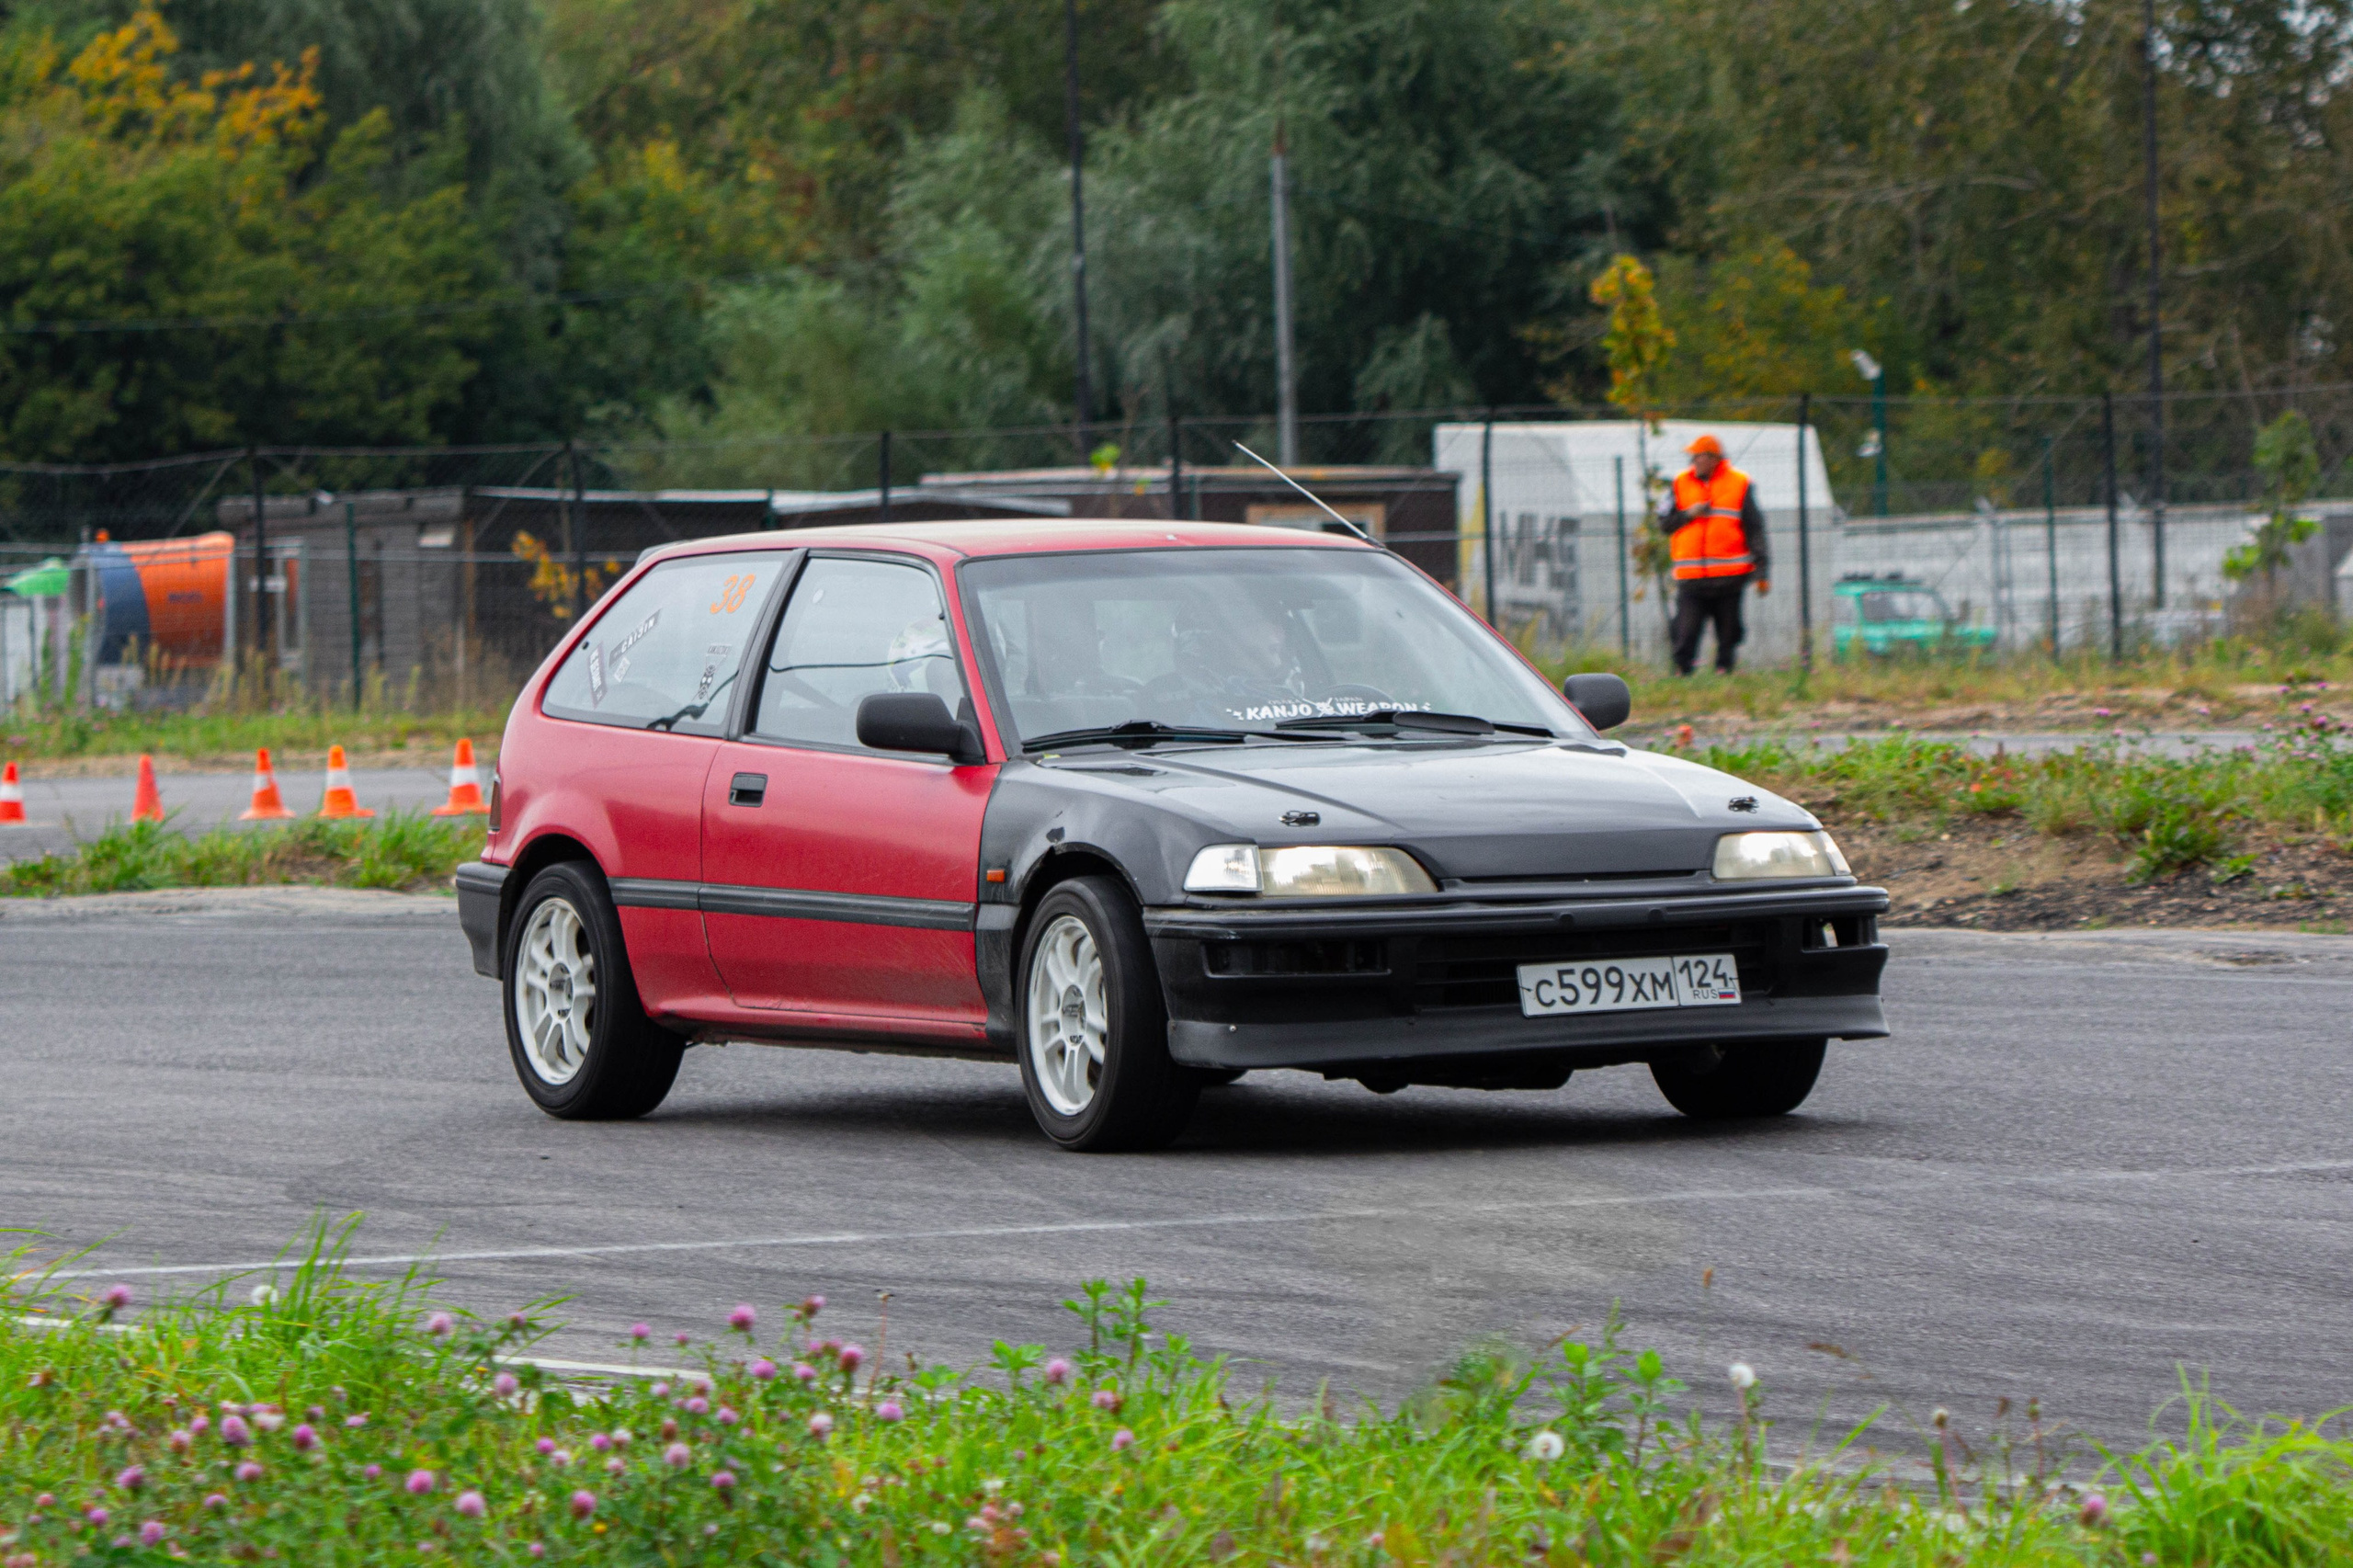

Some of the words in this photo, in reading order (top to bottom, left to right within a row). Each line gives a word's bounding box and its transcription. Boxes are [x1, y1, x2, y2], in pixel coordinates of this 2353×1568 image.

[710, 574, 756, 614] 38
[1246, 703, 1313, 721] KANJO
[1336, 701, 1417, 716] WEAPON
[1678, 959, 1729, 989] 124
[1692, 989, 1718, 1000] RUS
